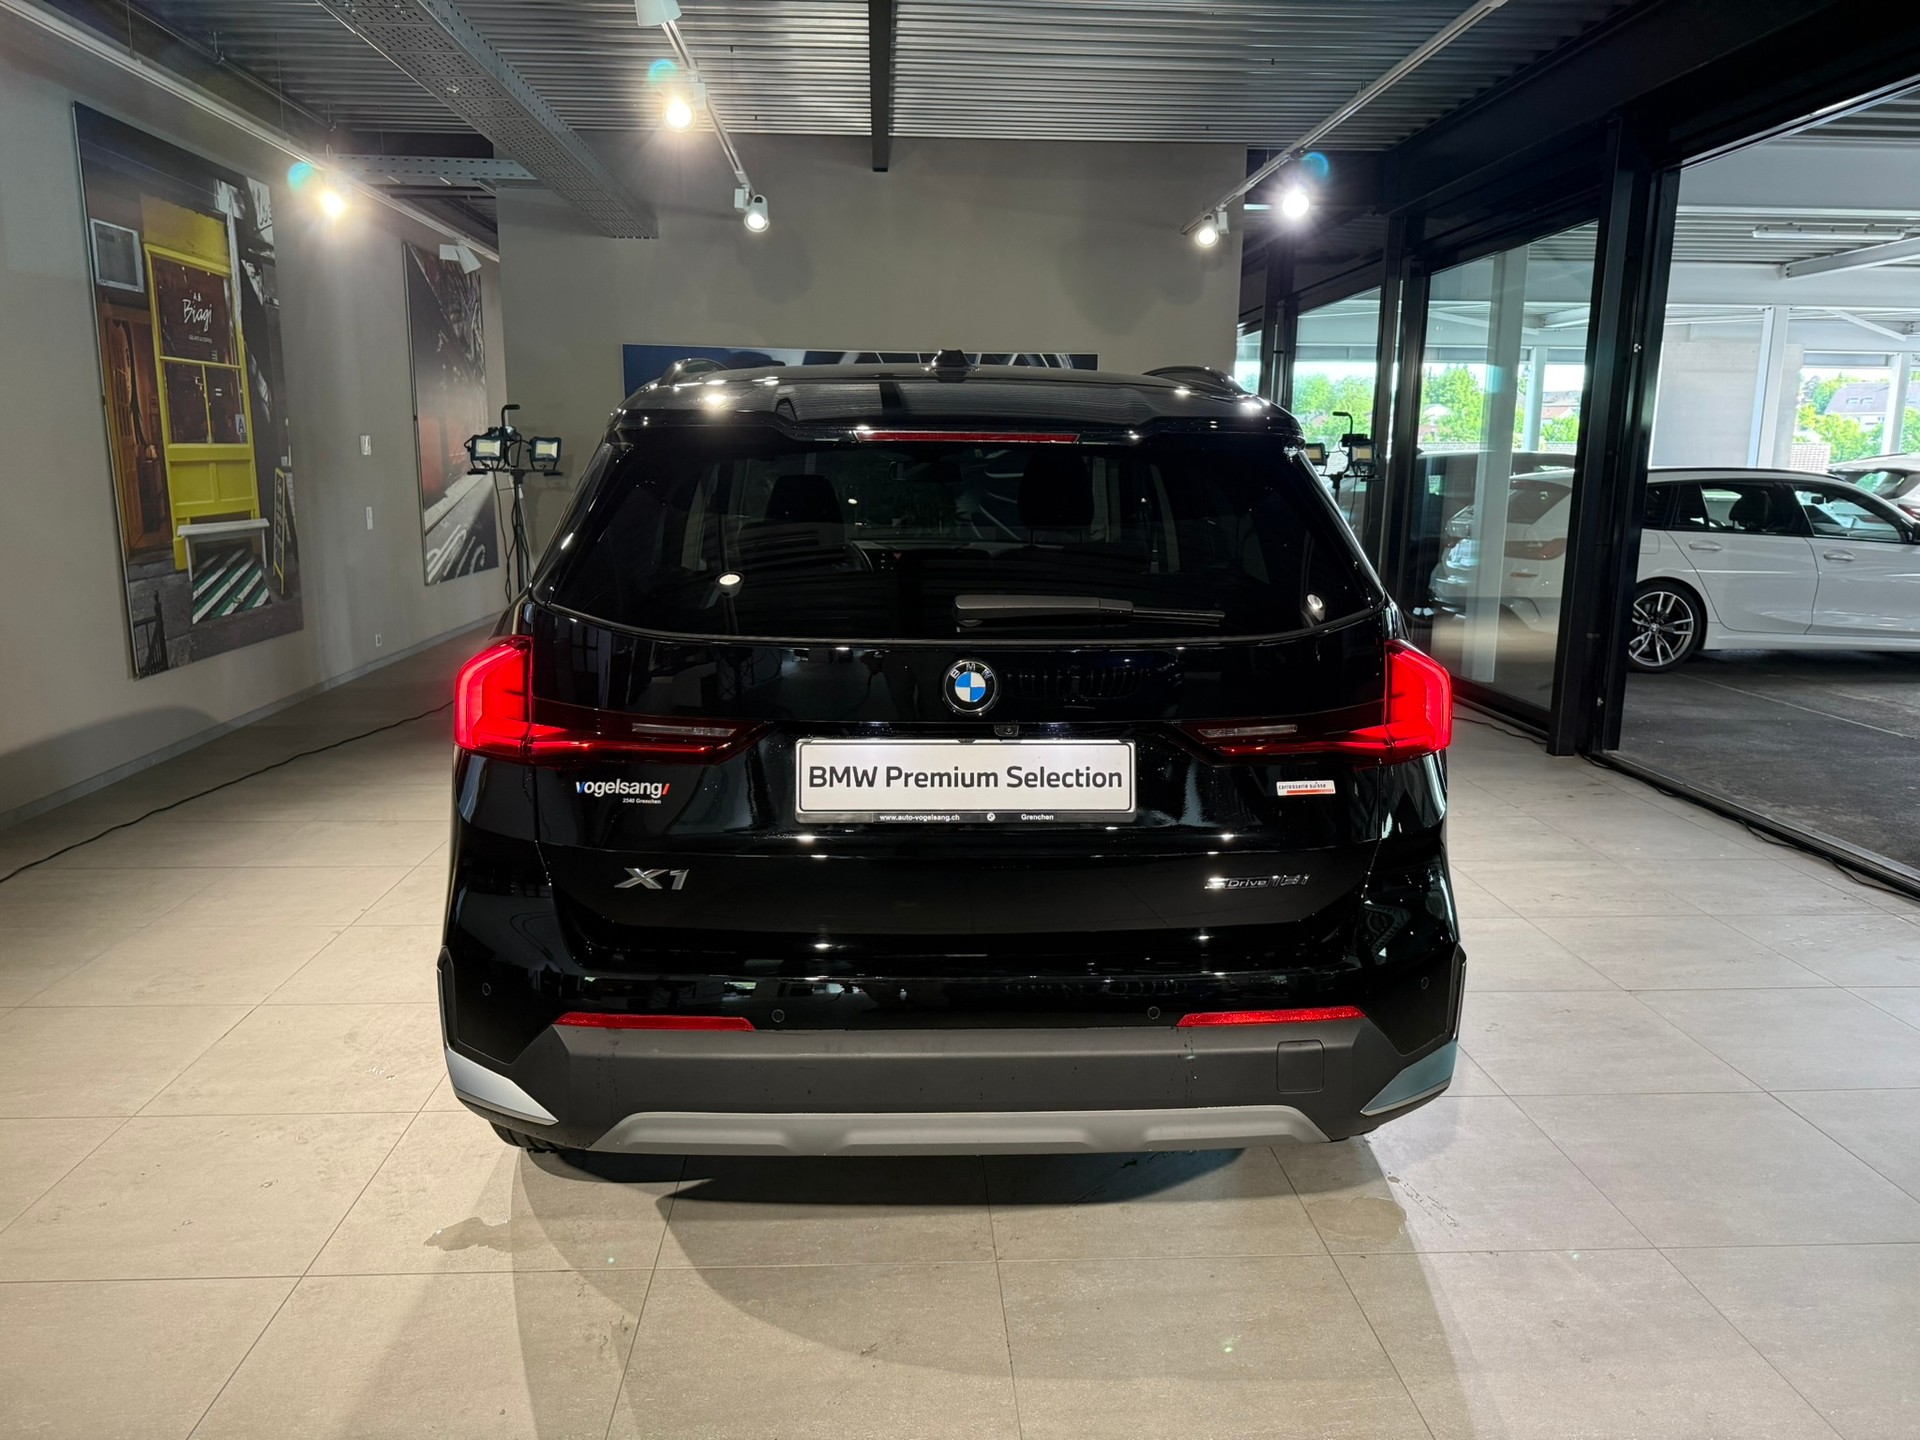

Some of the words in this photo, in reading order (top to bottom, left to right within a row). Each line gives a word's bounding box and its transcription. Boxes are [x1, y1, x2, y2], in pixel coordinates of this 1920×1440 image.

[182, 299, 212, 332] Biagi
[950, 662, 992, 680] BMW
[808, 765, 878, 788] BMW
[885, 765, 998, 788] Premium
[1006, 765, 1123, 788] Selection
[636, 797, 662, 805] Grenchen
[879, 813, 960, 822] www.auto-vogelsang.ch
[1021, 813, 1054, 821] Grenchen
[613, 867, 690, 891] X1
